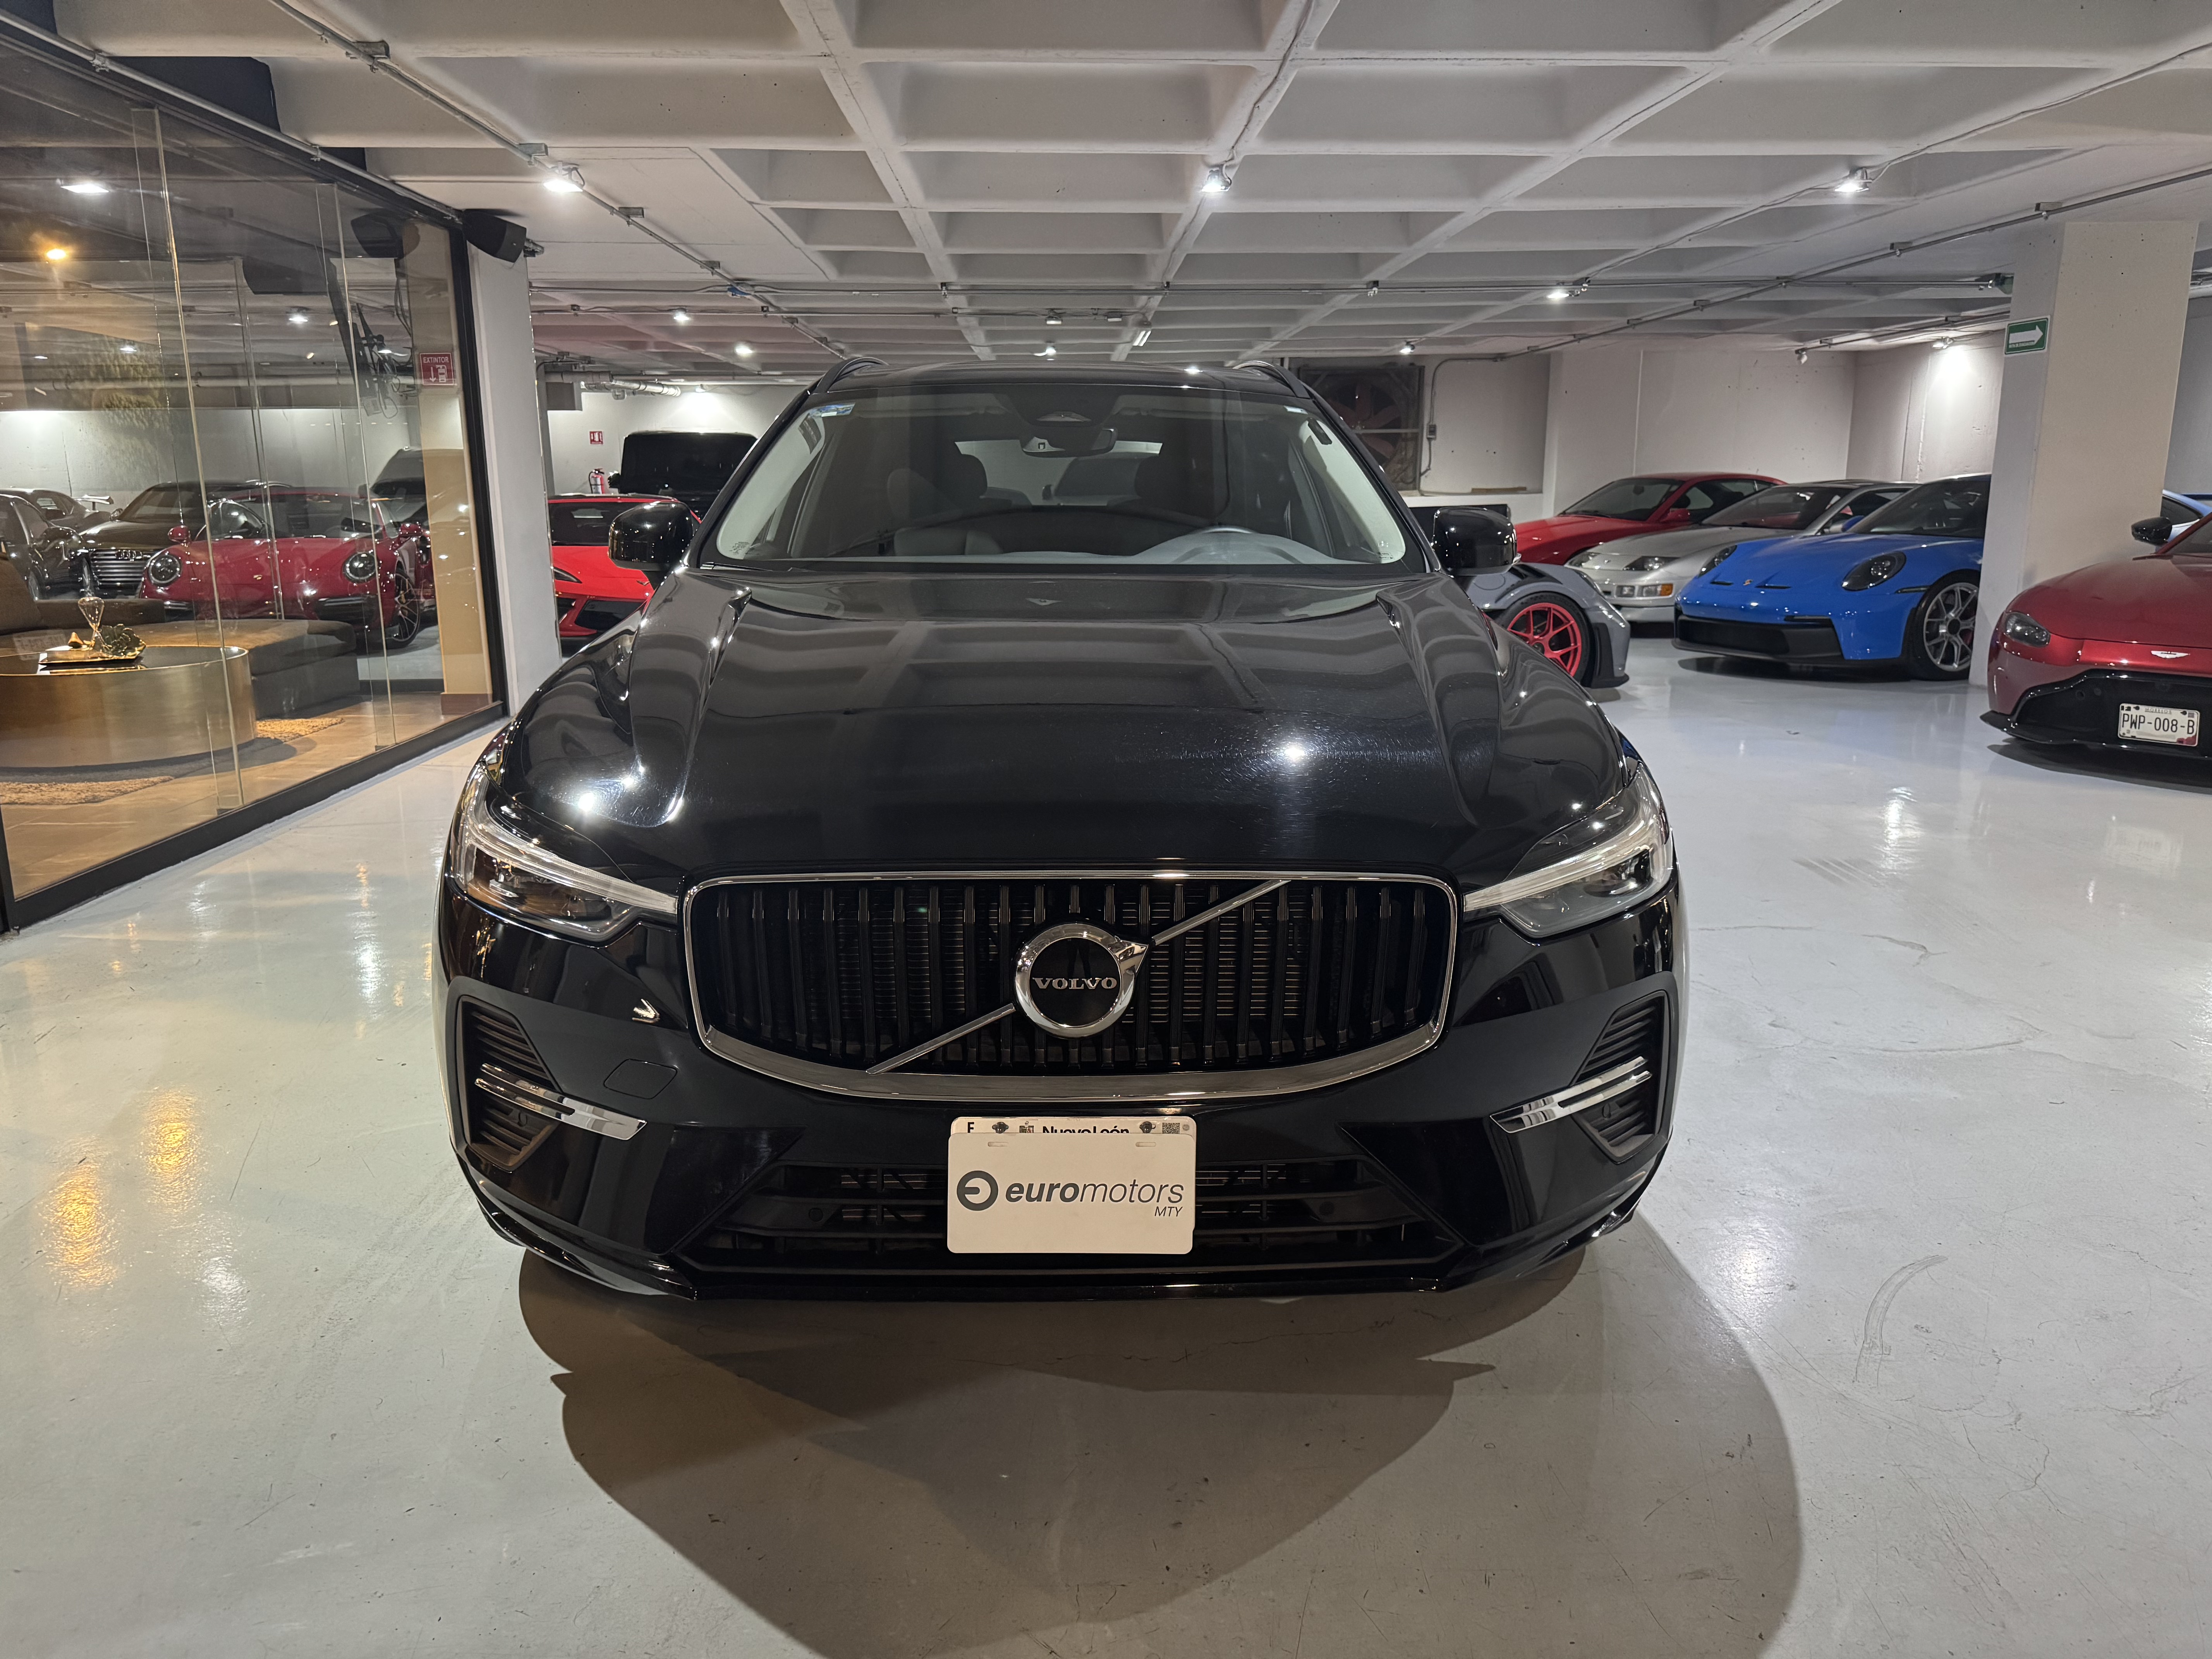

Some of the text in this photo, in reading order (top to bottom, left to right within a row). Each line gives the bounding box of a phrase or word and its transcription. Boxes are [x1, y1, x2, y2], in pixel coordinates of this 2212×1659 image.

[2122, 713, 2195, 735] PWP-008-B
[1032, 977, 1117, 989] VOLVO
[1006, 1179, 1184, 1203] euromotors
[1154, 1206, 1183, 1217] MTY
